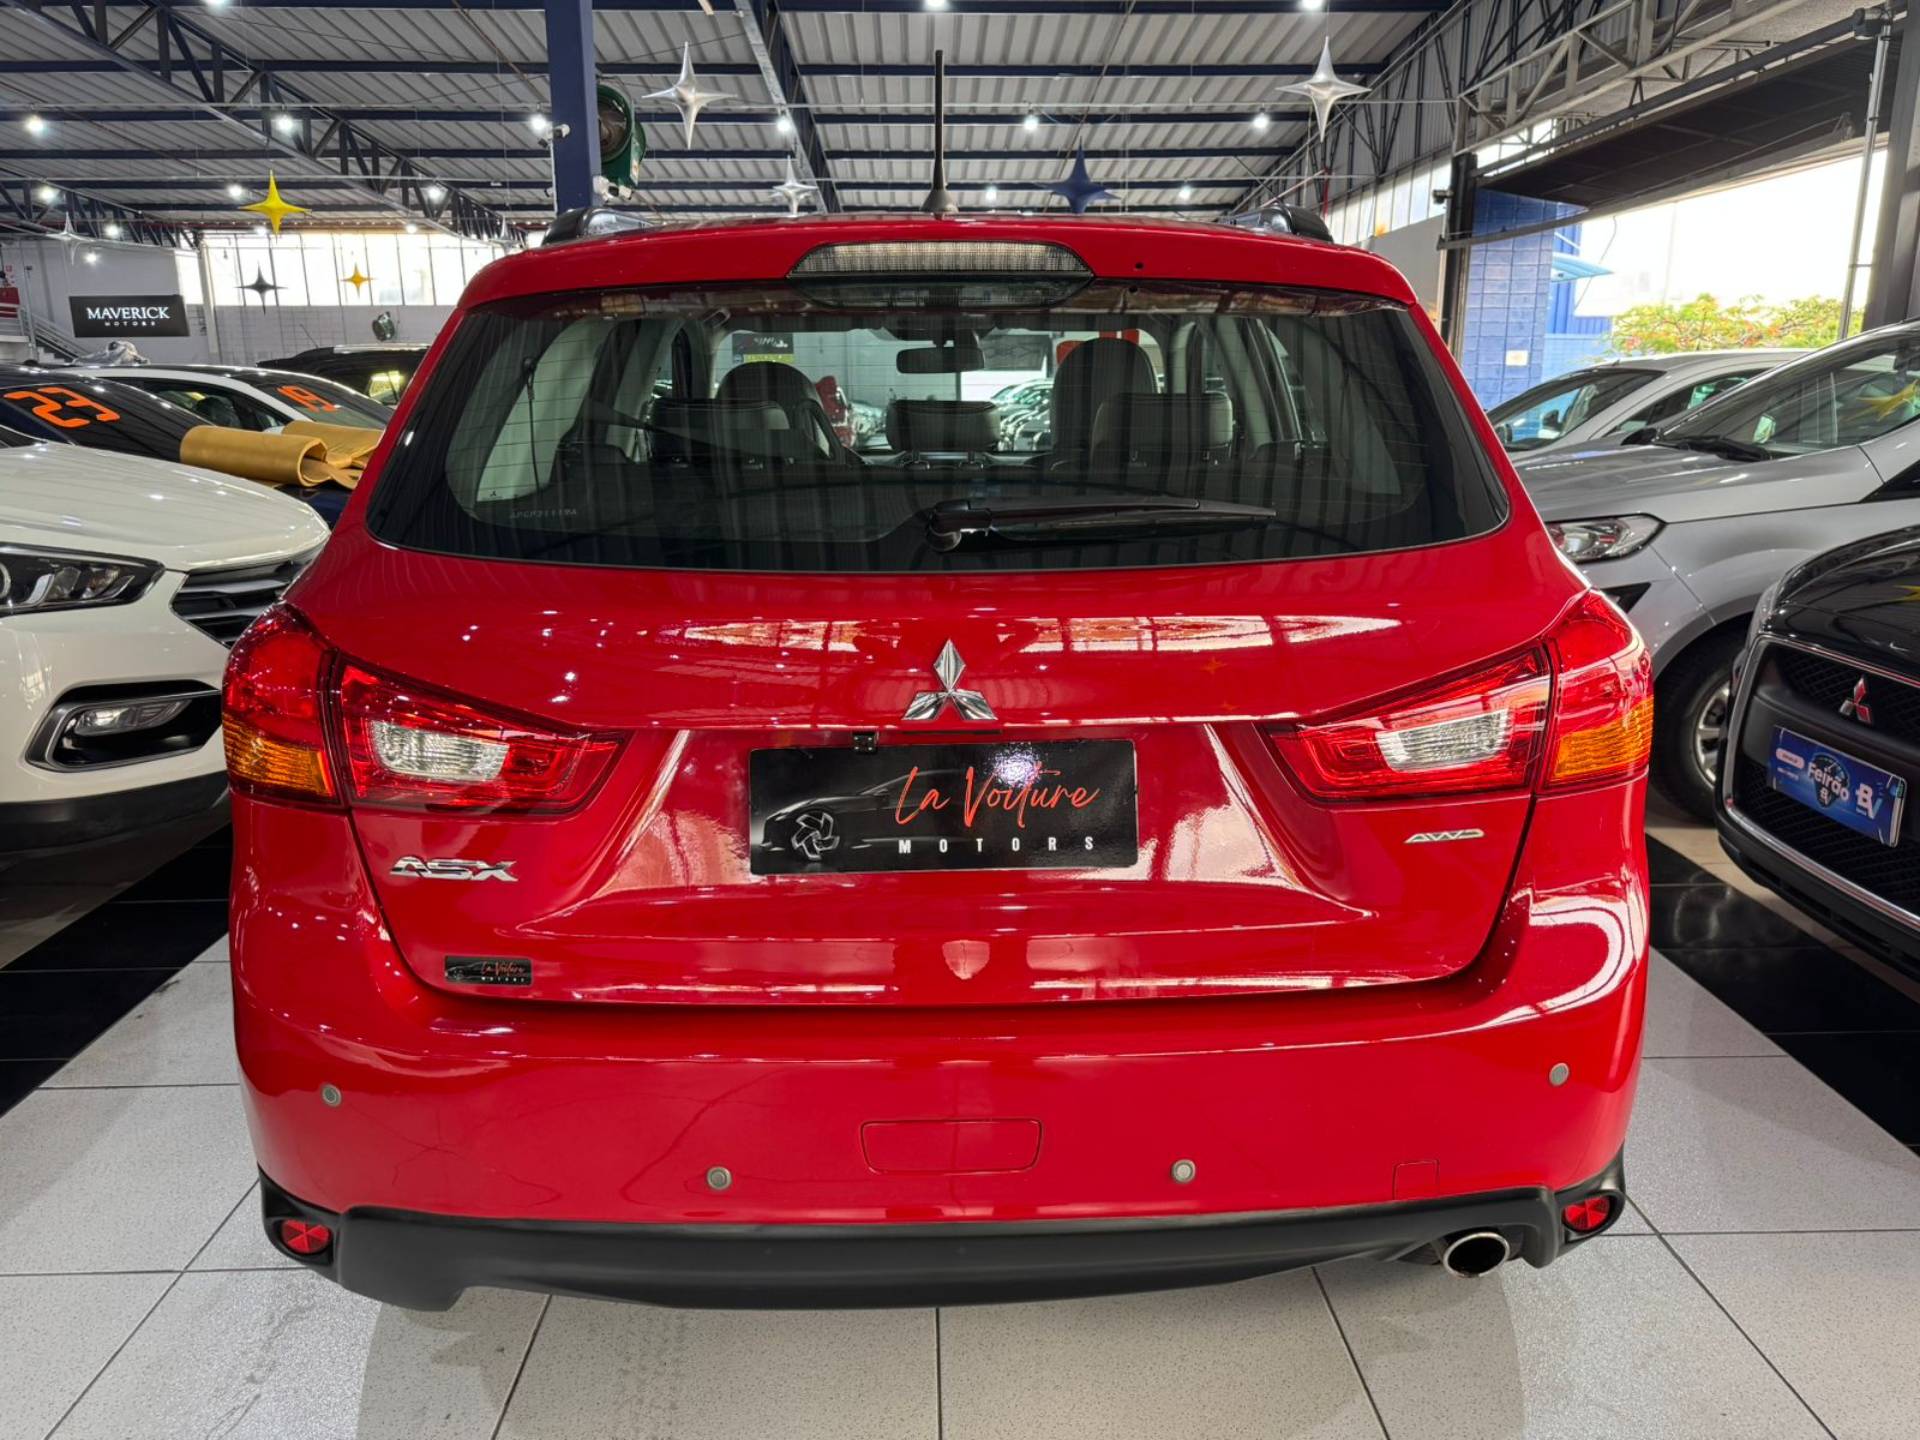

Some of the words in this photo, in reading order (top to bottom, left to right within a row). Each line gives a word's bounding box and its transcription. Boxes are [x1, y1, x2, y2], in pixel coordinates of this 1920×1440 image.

[86, 306, 170, 320] MAVERICK
[3, 386, 120, 428] 23
[894, 765, 950, 826] La
[898, 836, 1095, 855] MOTORS
[389, 856, 519, 882] ASX
